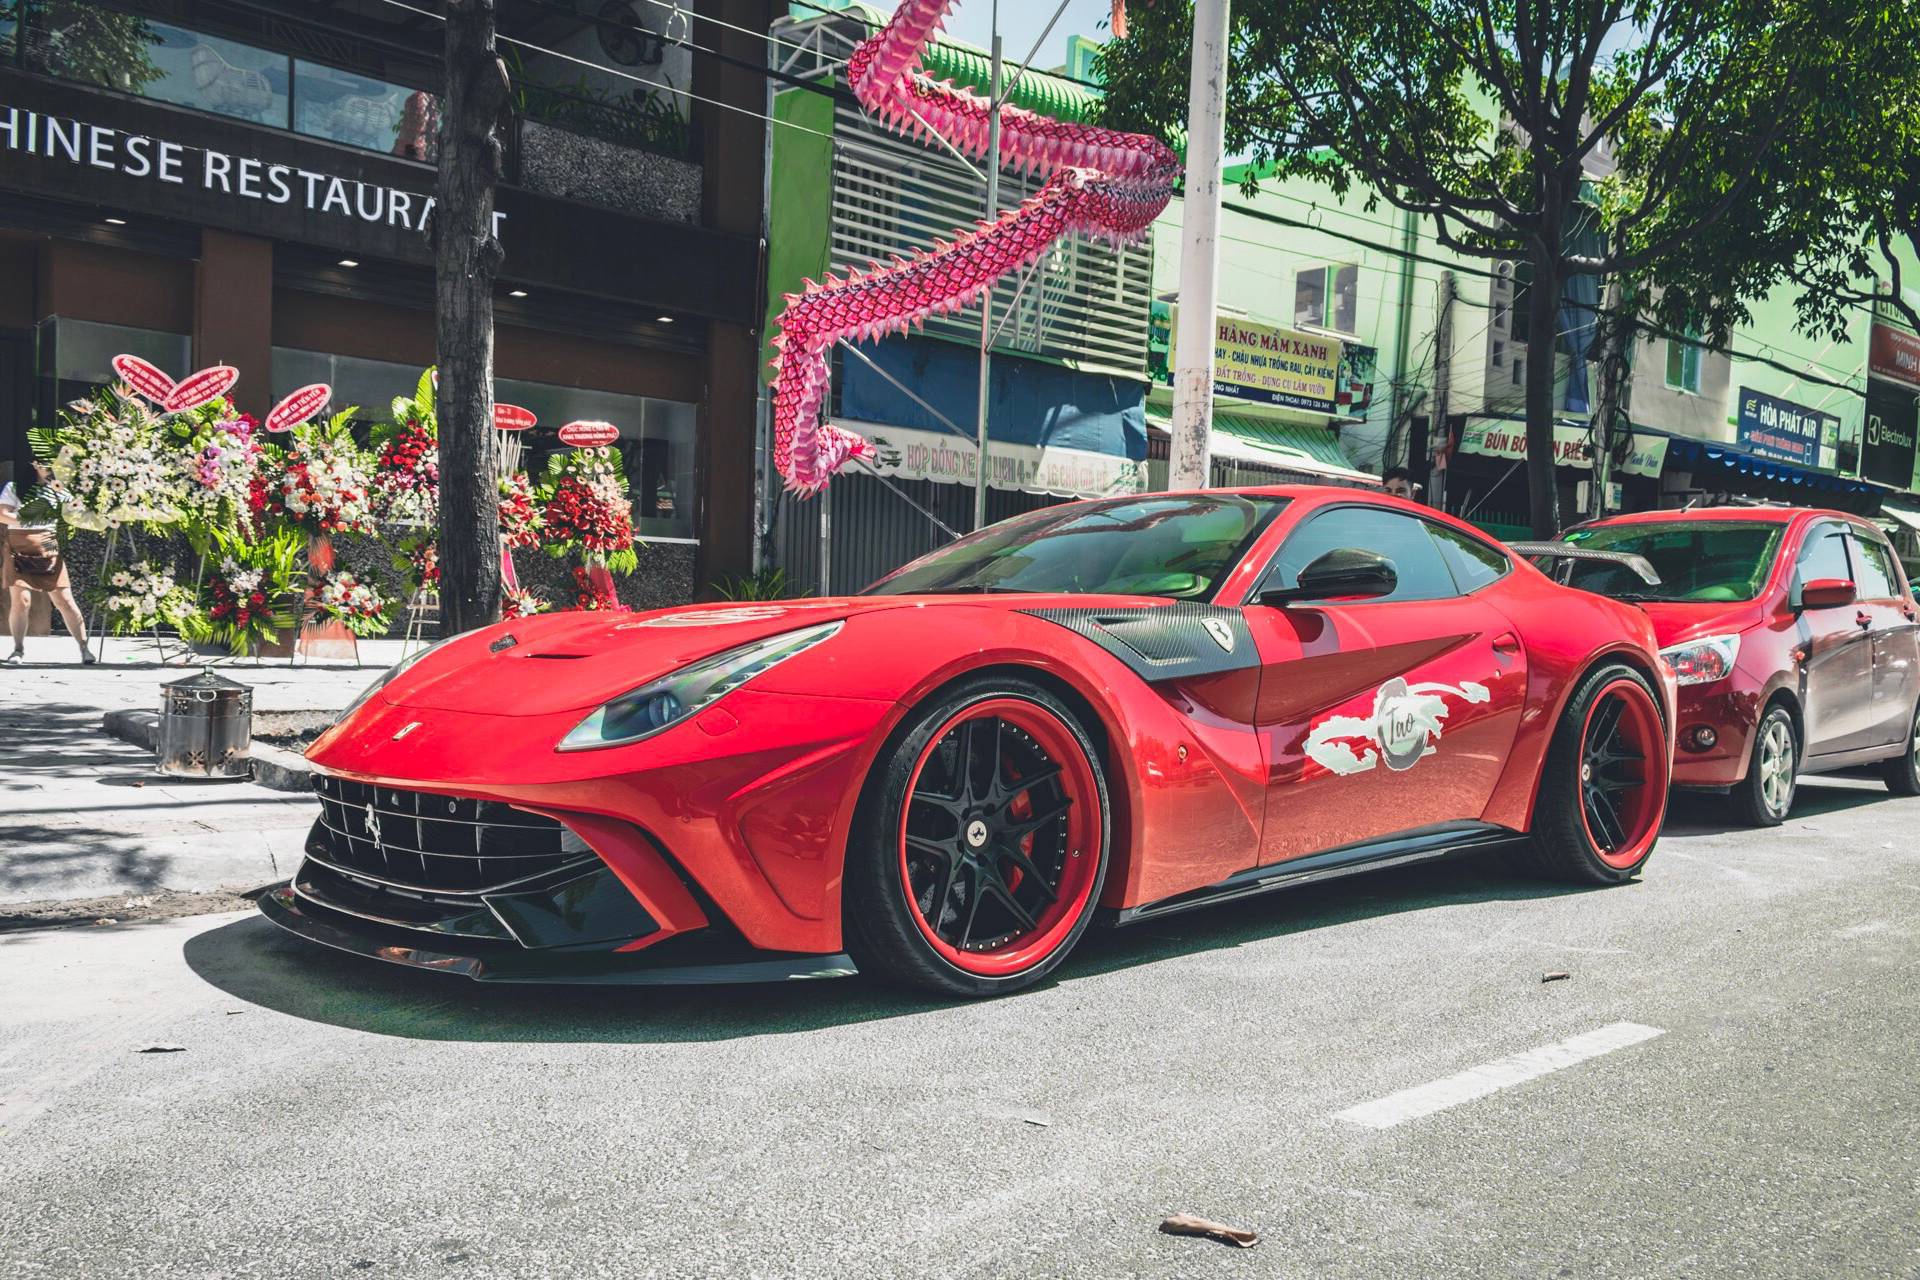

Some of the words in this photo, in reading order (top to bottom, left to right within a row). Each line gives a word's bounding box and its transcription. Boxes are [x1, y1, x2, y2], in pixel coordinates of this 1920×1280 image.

[204, 150, 507, 240] RESTAURAT
[1219, 324, 1257, 346] HÀNG
[1292, 340, 1328, 361] XANH
[1760, 402, 1777, 428] HÒA
[1779, 410, 1801, 435] PHÁT
[1802, 417, 1817, 439] AIR
[1881, 425, 1912, 449] Electrolux
[1484, 429, 1510, 451] BÚN
[907, 443, 929, 477] HỢP
